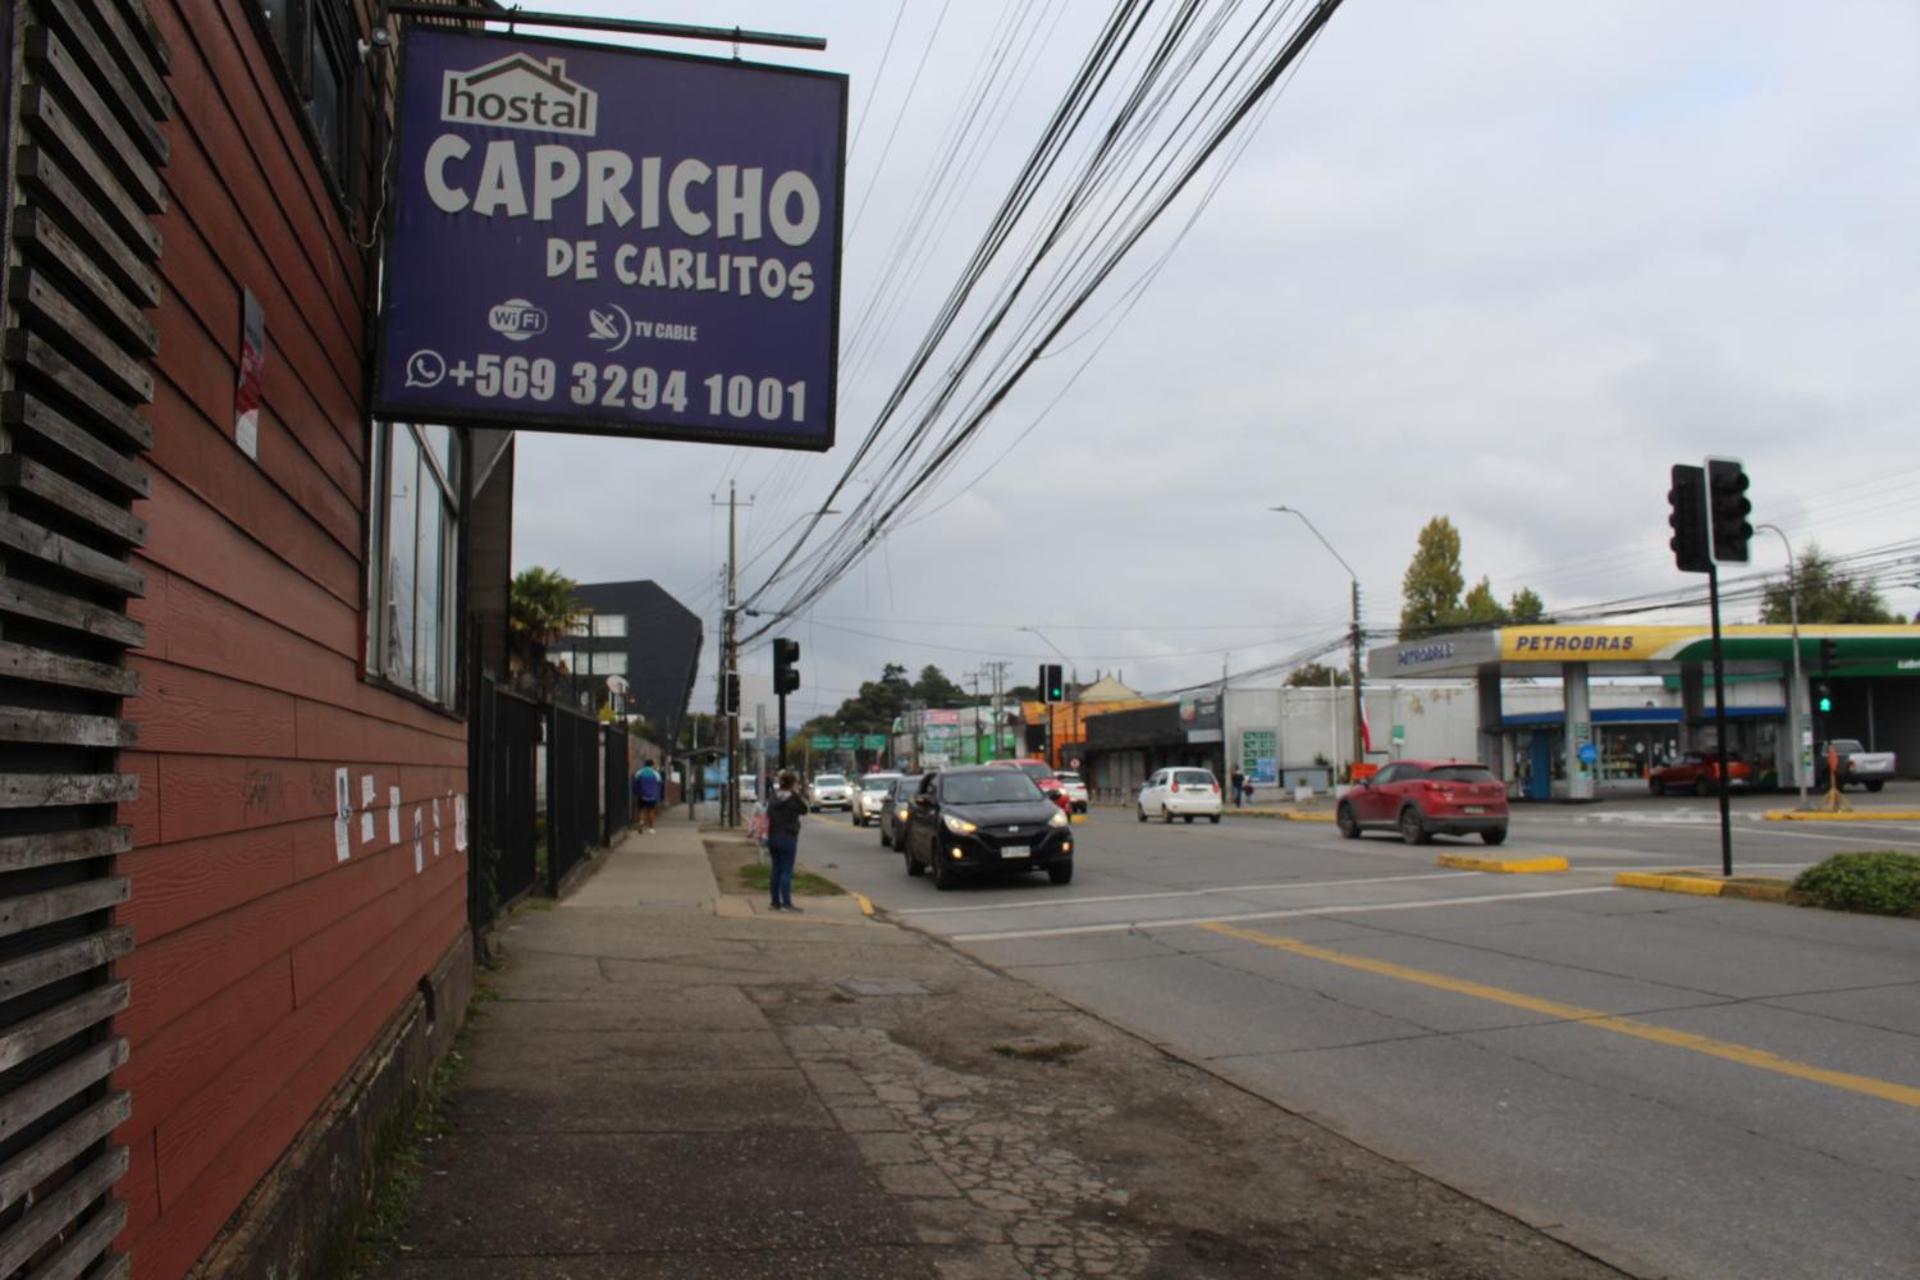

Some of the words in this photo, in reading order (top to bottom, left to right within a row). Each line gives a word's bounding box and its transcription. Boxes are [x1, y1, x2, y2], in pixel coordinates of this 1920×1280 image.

[447, 77, 588, 130] hostal
[424, 133, 820, 247] CAPRICHO
[547, 237, 598, 280] DE
[614, 243, 815, 301] CARLITOS
[635, 321, 653, 338] TV
[655, 321, 697, 341] CABLE
[449, 354, 556, 401] +569
[571, 361, 688, 412] 3294
[705, 373, 807, 422] 1001
[1516, 635, 1634, 651] PETROBRAS
